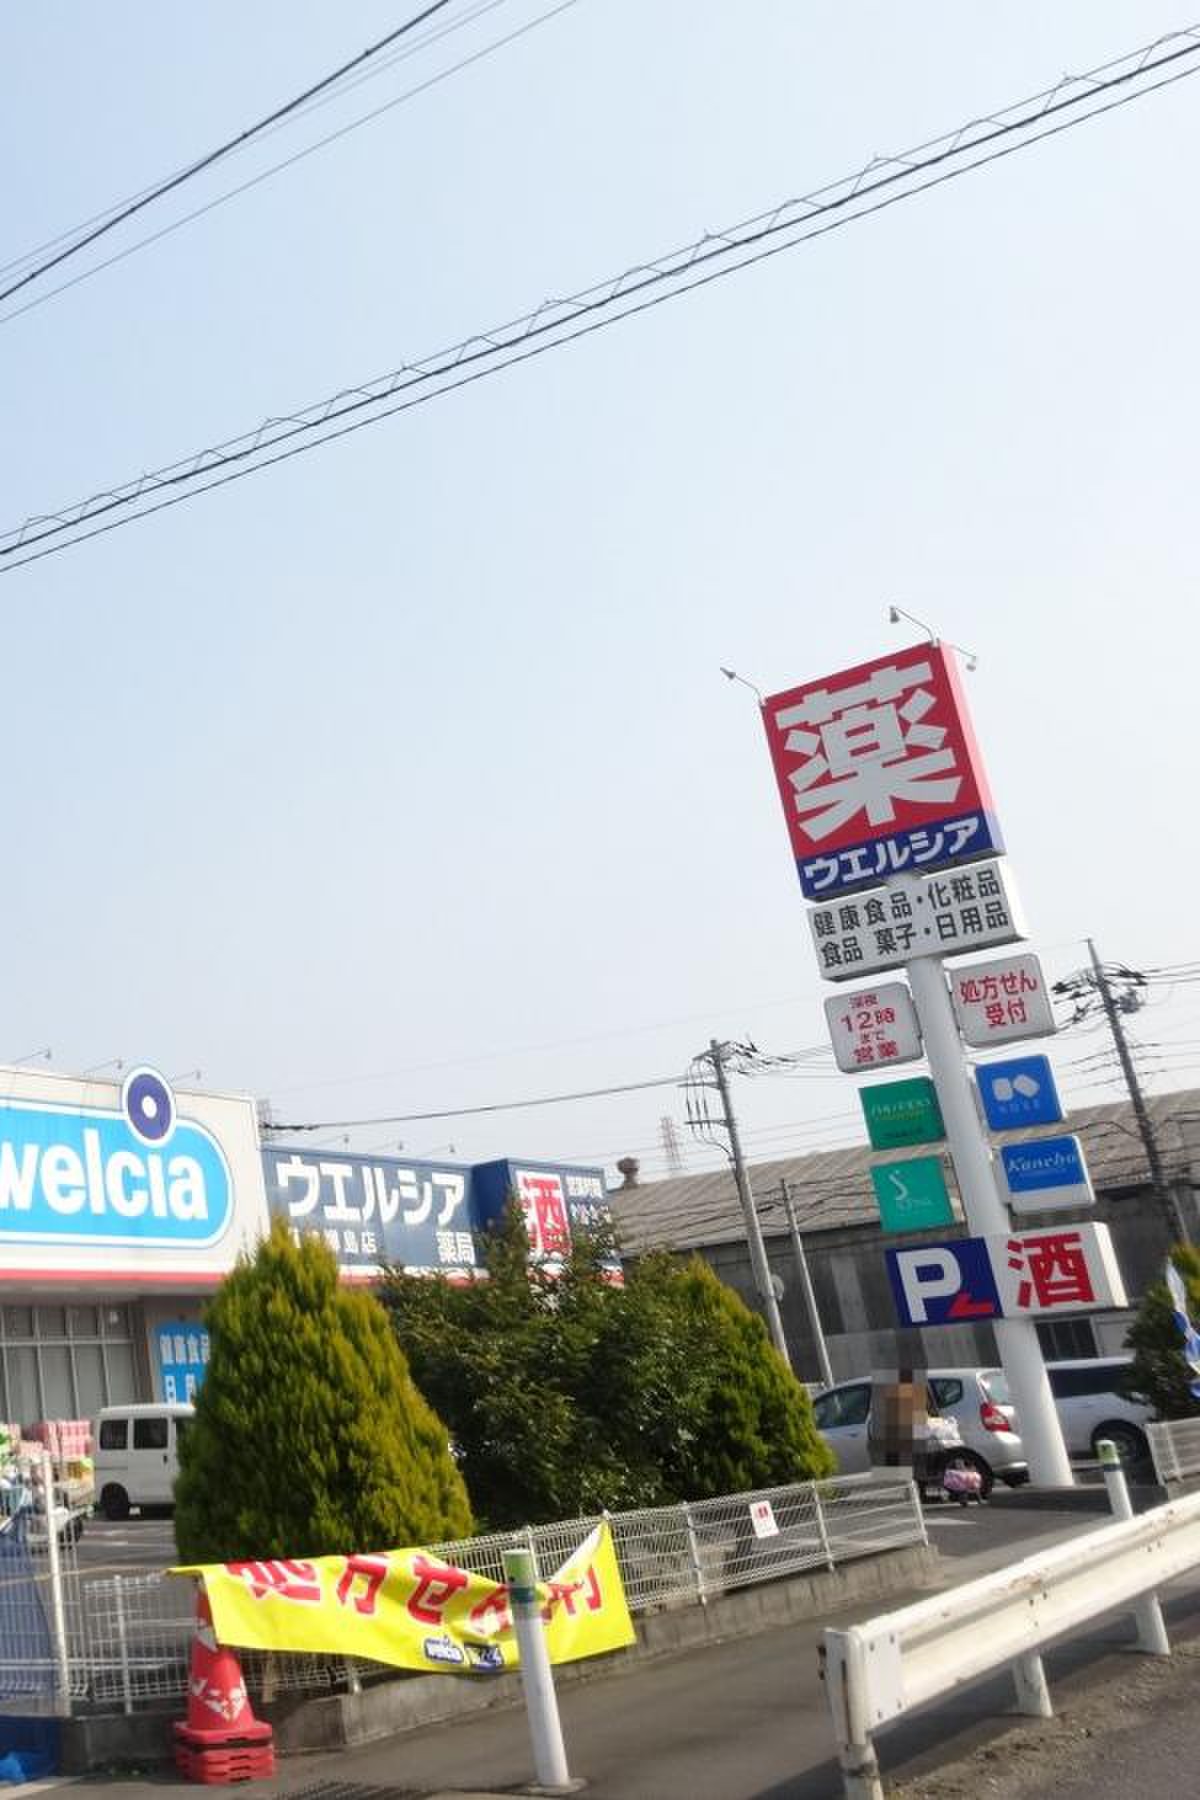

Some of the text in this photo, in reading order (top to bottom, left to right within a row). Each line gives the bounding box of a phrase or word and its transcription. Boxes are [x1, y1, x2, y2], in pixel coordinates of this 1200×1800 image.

[775, 661, 963, 841] 薬
[803, 816, 980, 891] ウエルシア
[813, 869, 1001, 939] 健康食品・化粧品
[821, 936, 864, 969] 食品
[959, 969, 1038, 1004] 処方せん
[984, 1000, 1028, 1029] 受付
[276, 1153, 467, 1225] ウエルシア
[435, 1231, 477, 1265] 薬局
[1007, 1232, 1096, 1308] 酒
[895, 1247, 962, 1324] P
